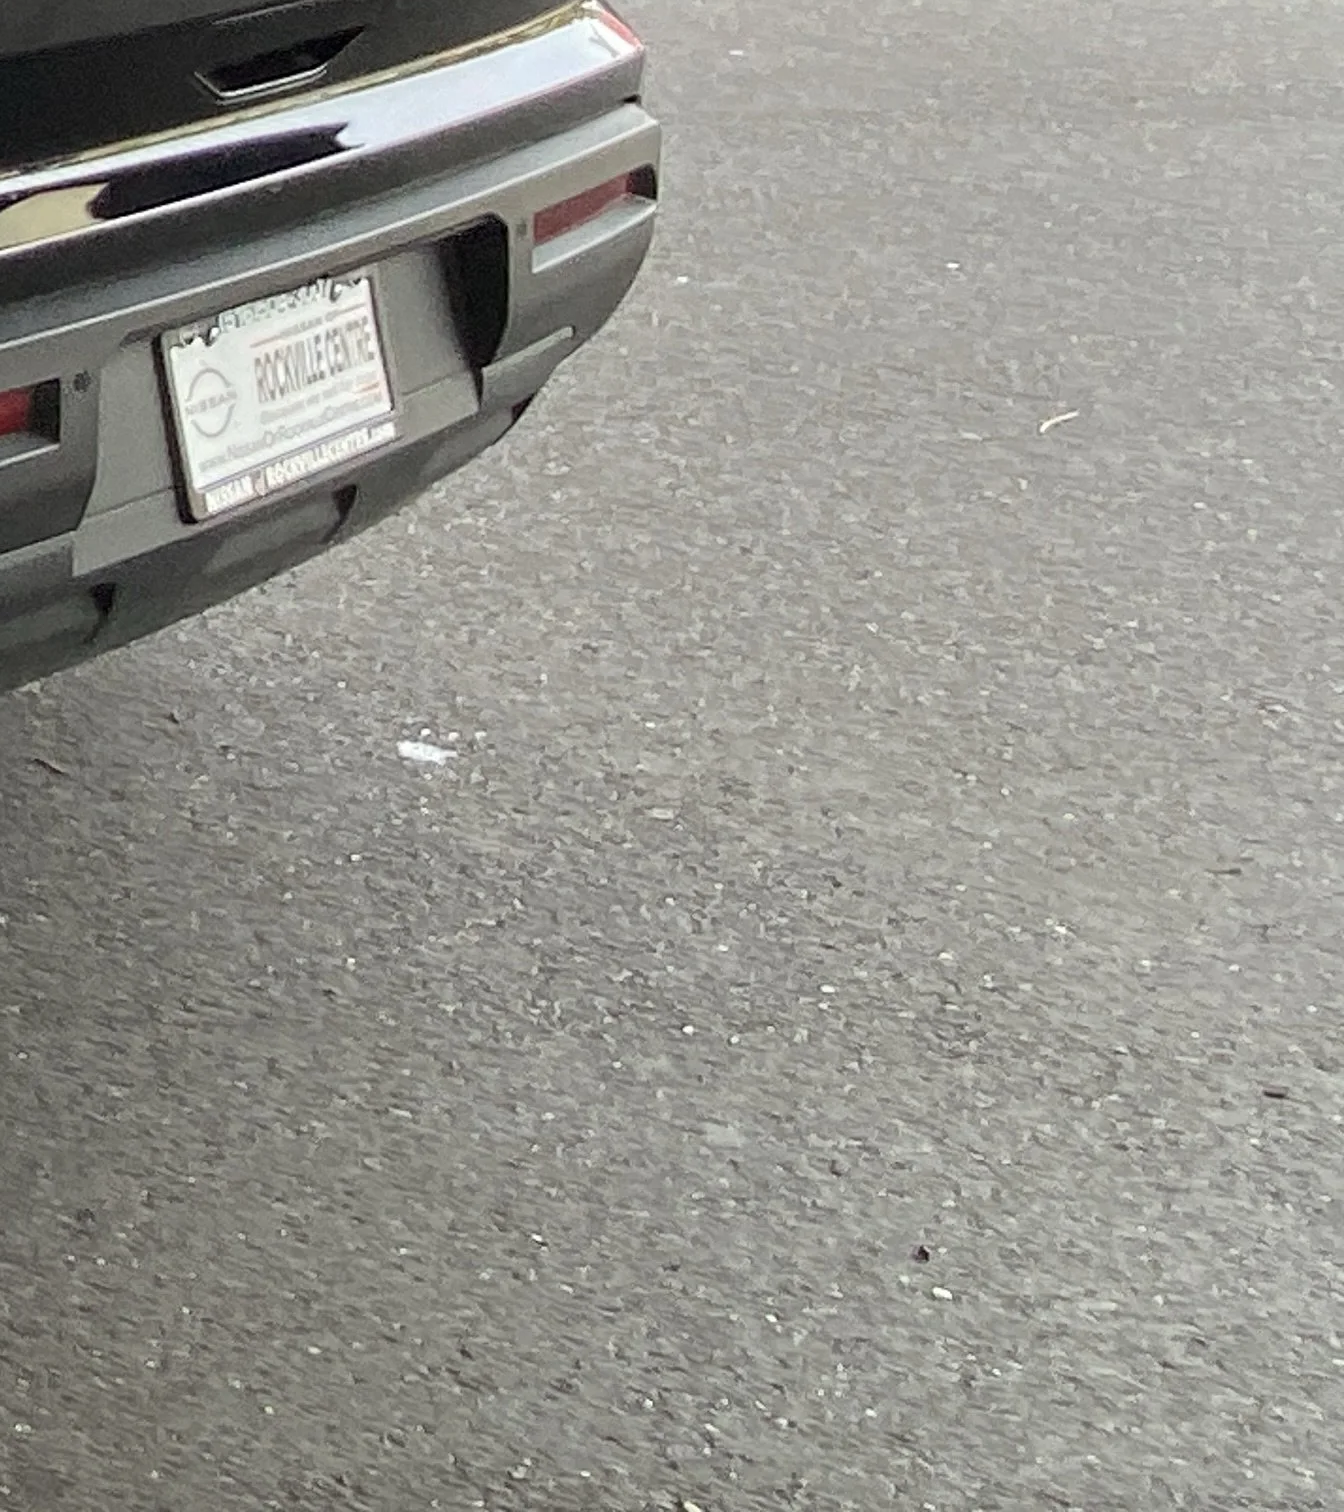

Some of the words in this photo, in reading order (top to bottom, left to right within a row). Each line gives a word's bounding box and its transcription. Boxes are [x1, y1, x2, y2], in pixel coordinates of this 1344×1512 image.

[254, 333, 326, 404] ROCKVILLE
[324, 315, 375, 377] CENTRE
[184, 390, 238, 416] NISSAN
